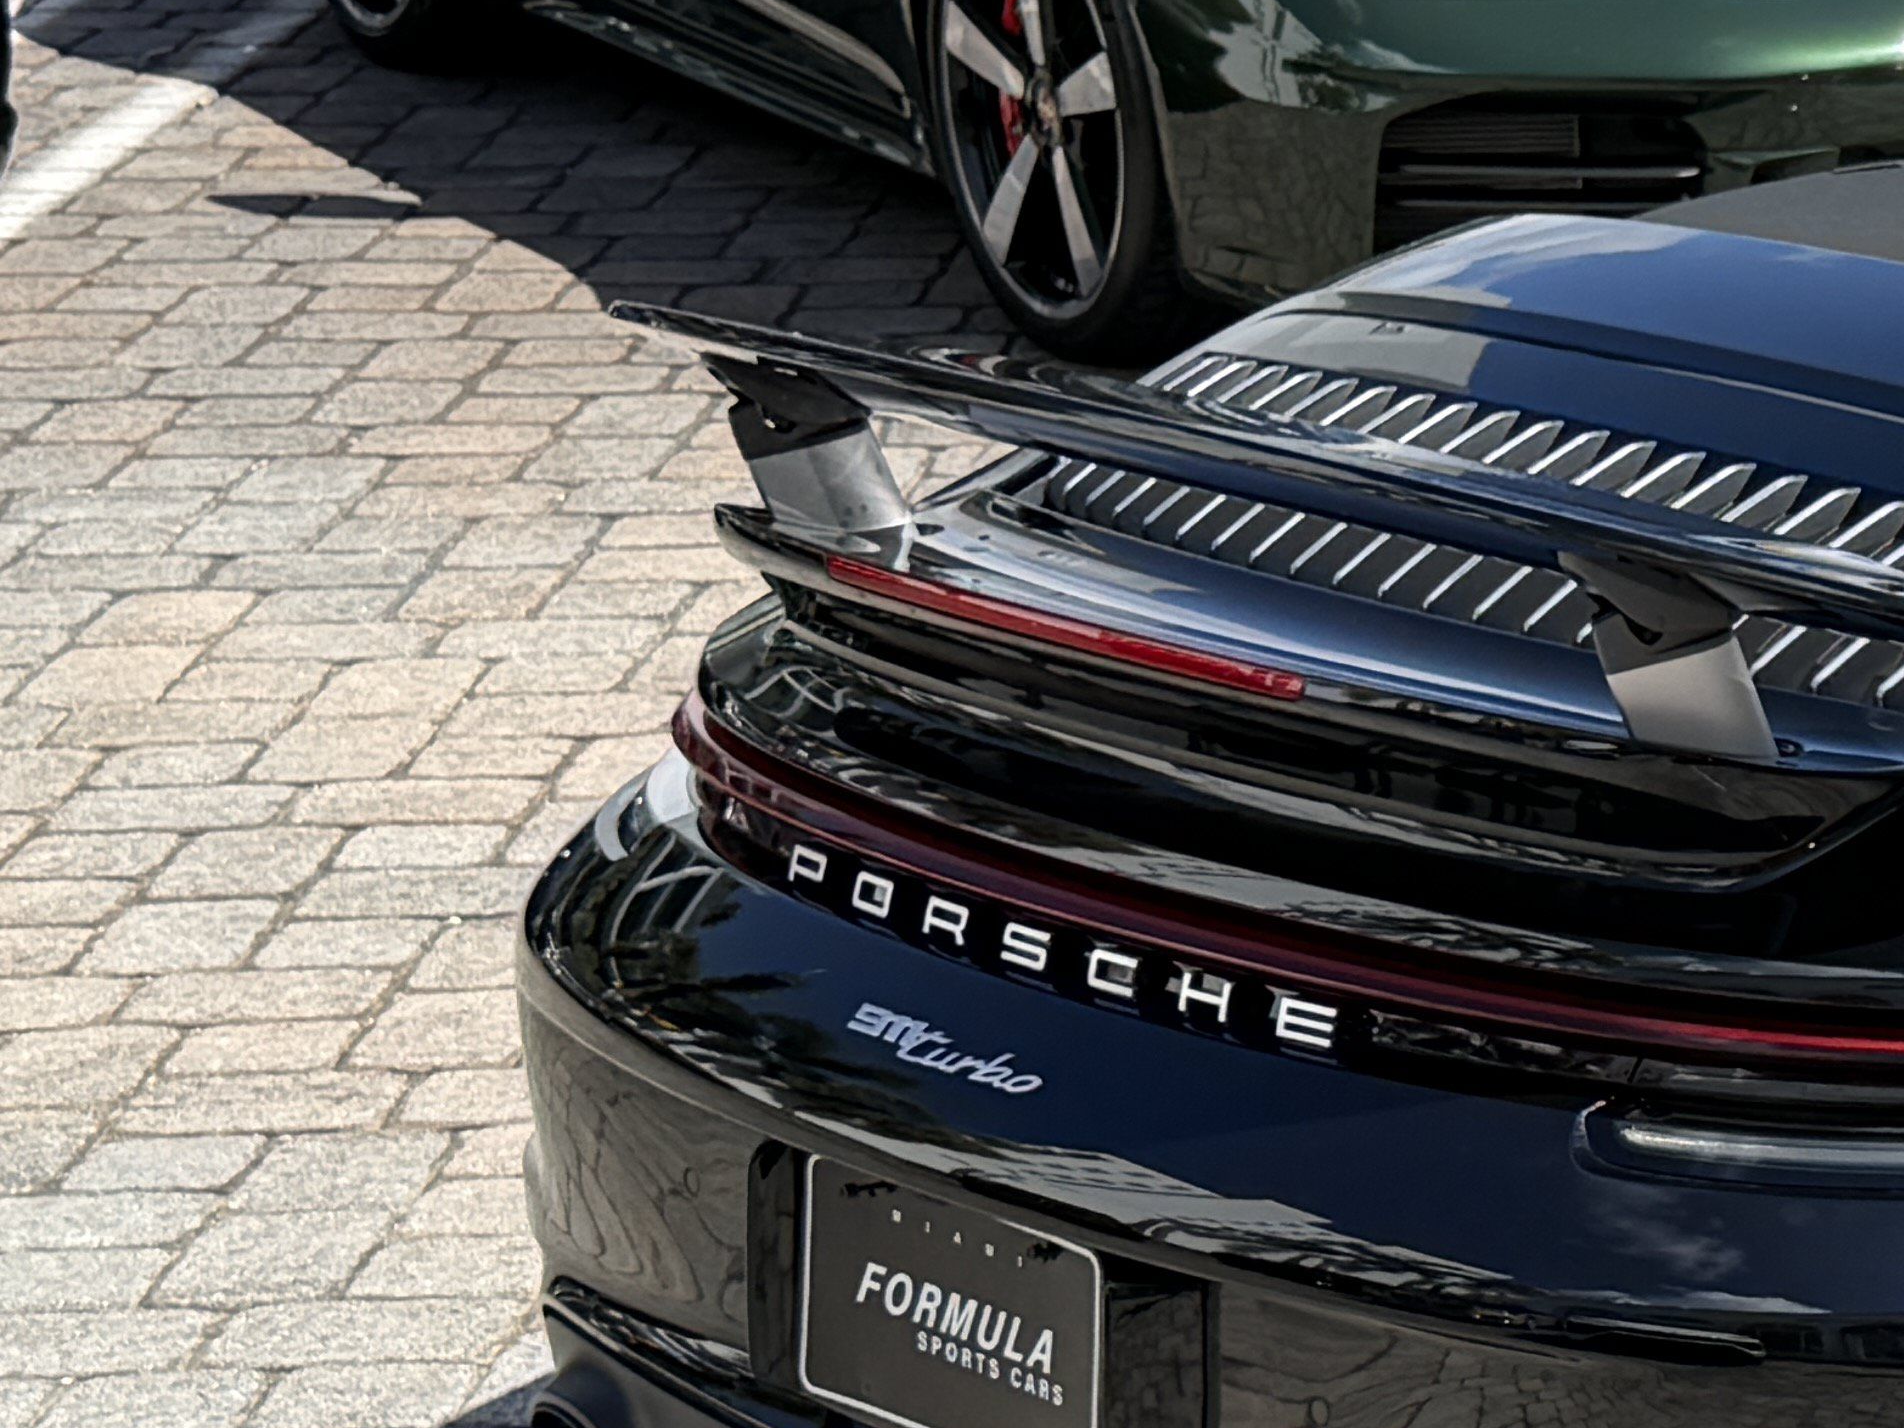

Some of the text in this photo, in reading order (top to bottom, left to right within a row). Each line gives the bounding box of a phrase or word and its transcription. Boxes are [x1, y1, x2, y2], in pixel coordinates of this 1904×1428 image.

[787, 844, 1338, 1048] PORSCHE
[856, 1262, 1054, 1375] FORMULA
[916, 1330, 1064, 1406] SPORTS CARS
